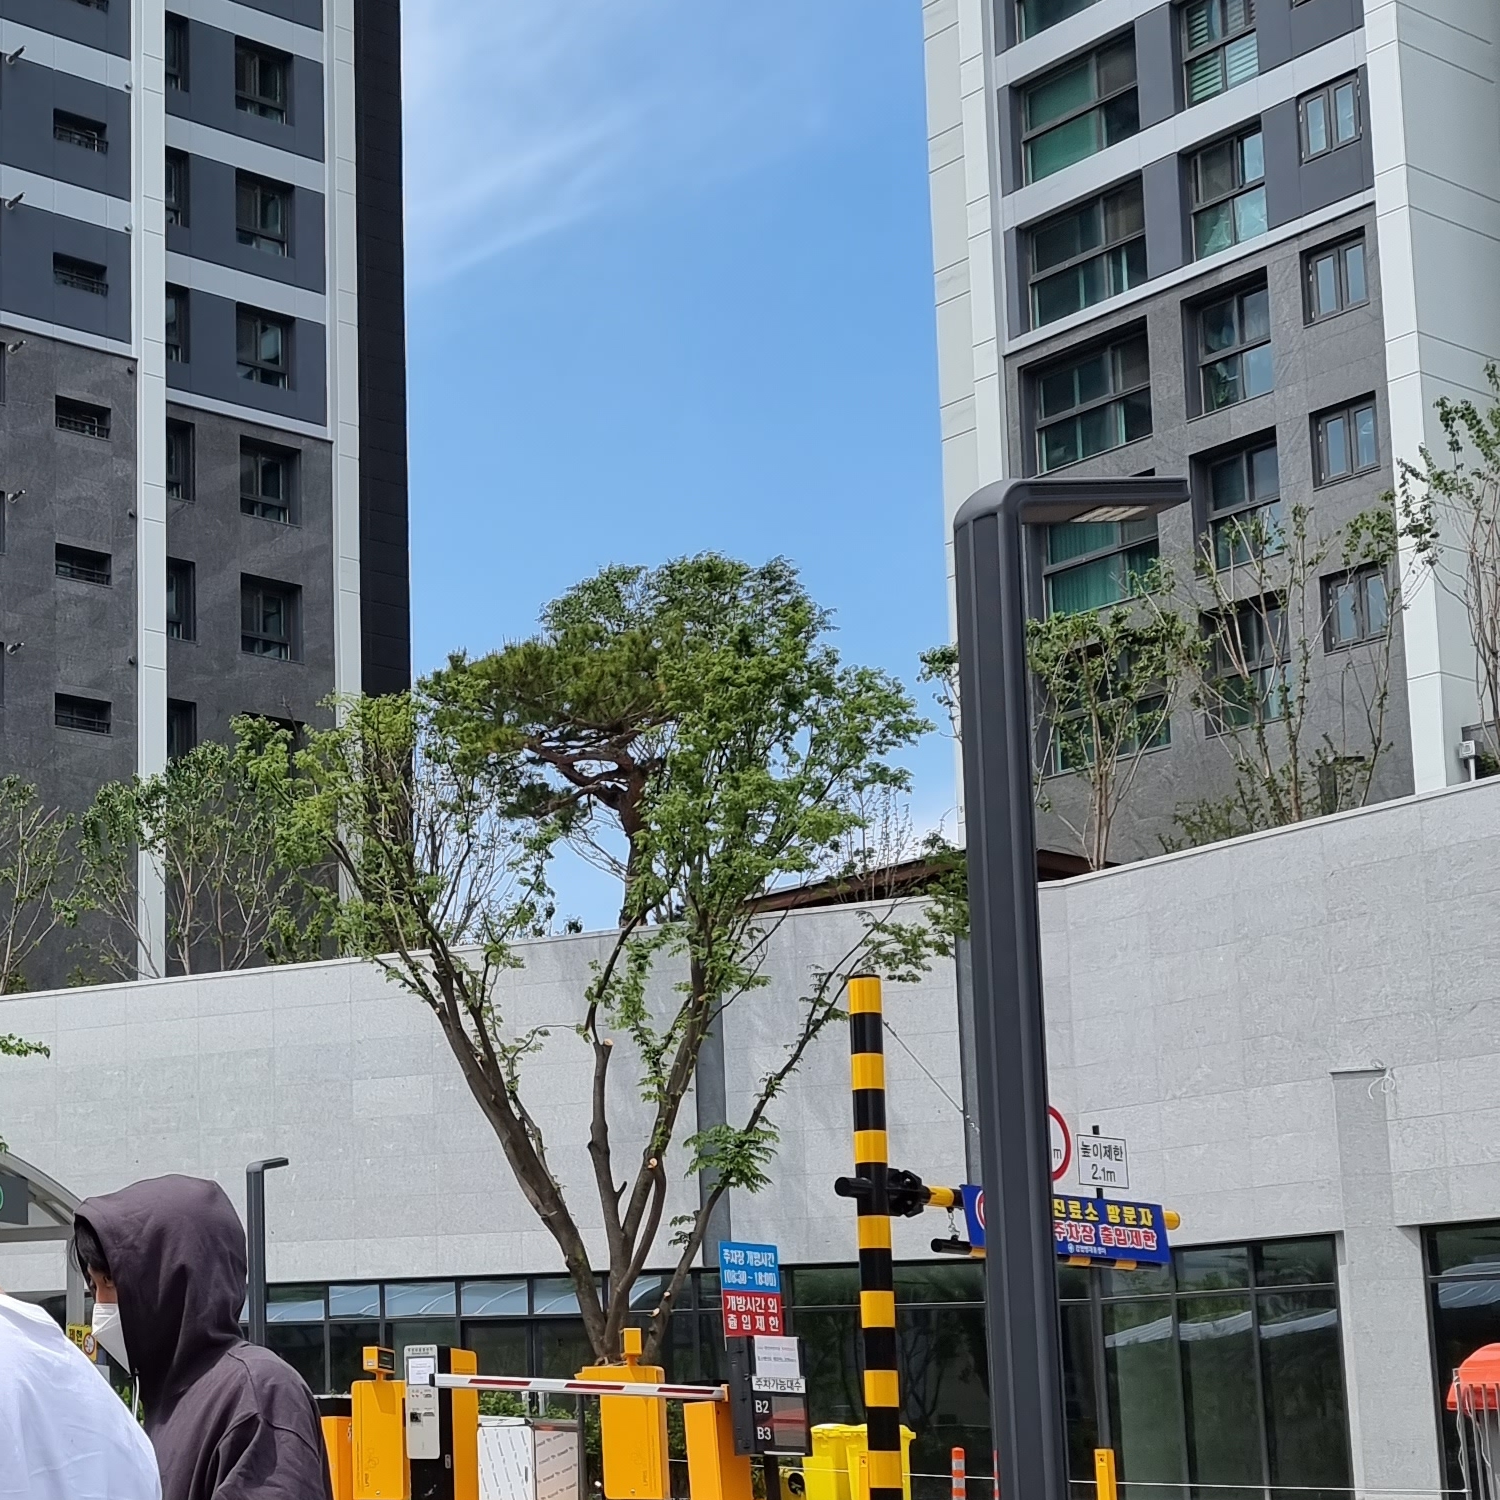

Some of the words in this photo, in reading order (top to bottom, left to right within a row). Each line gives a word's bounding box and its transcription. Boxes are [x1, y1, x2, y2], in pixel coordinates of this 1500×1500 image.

[1080, 1141, 1123, 1162] 높이제한
[1091, 1163, 1117, 1183] 2.1m
[1106, 1204, 1153, 1226] 방문자
[1053, 1220, 1095, 1243] 주차장
[1100, 1224, 1157, 1250] 출입제한
[726, 1295, 765, 1312] 개방시간
[767, 1298, 778, 1313] 외
[755, 1400, 770, 1414] B2
[757, 1426, 771, 1440] B3
